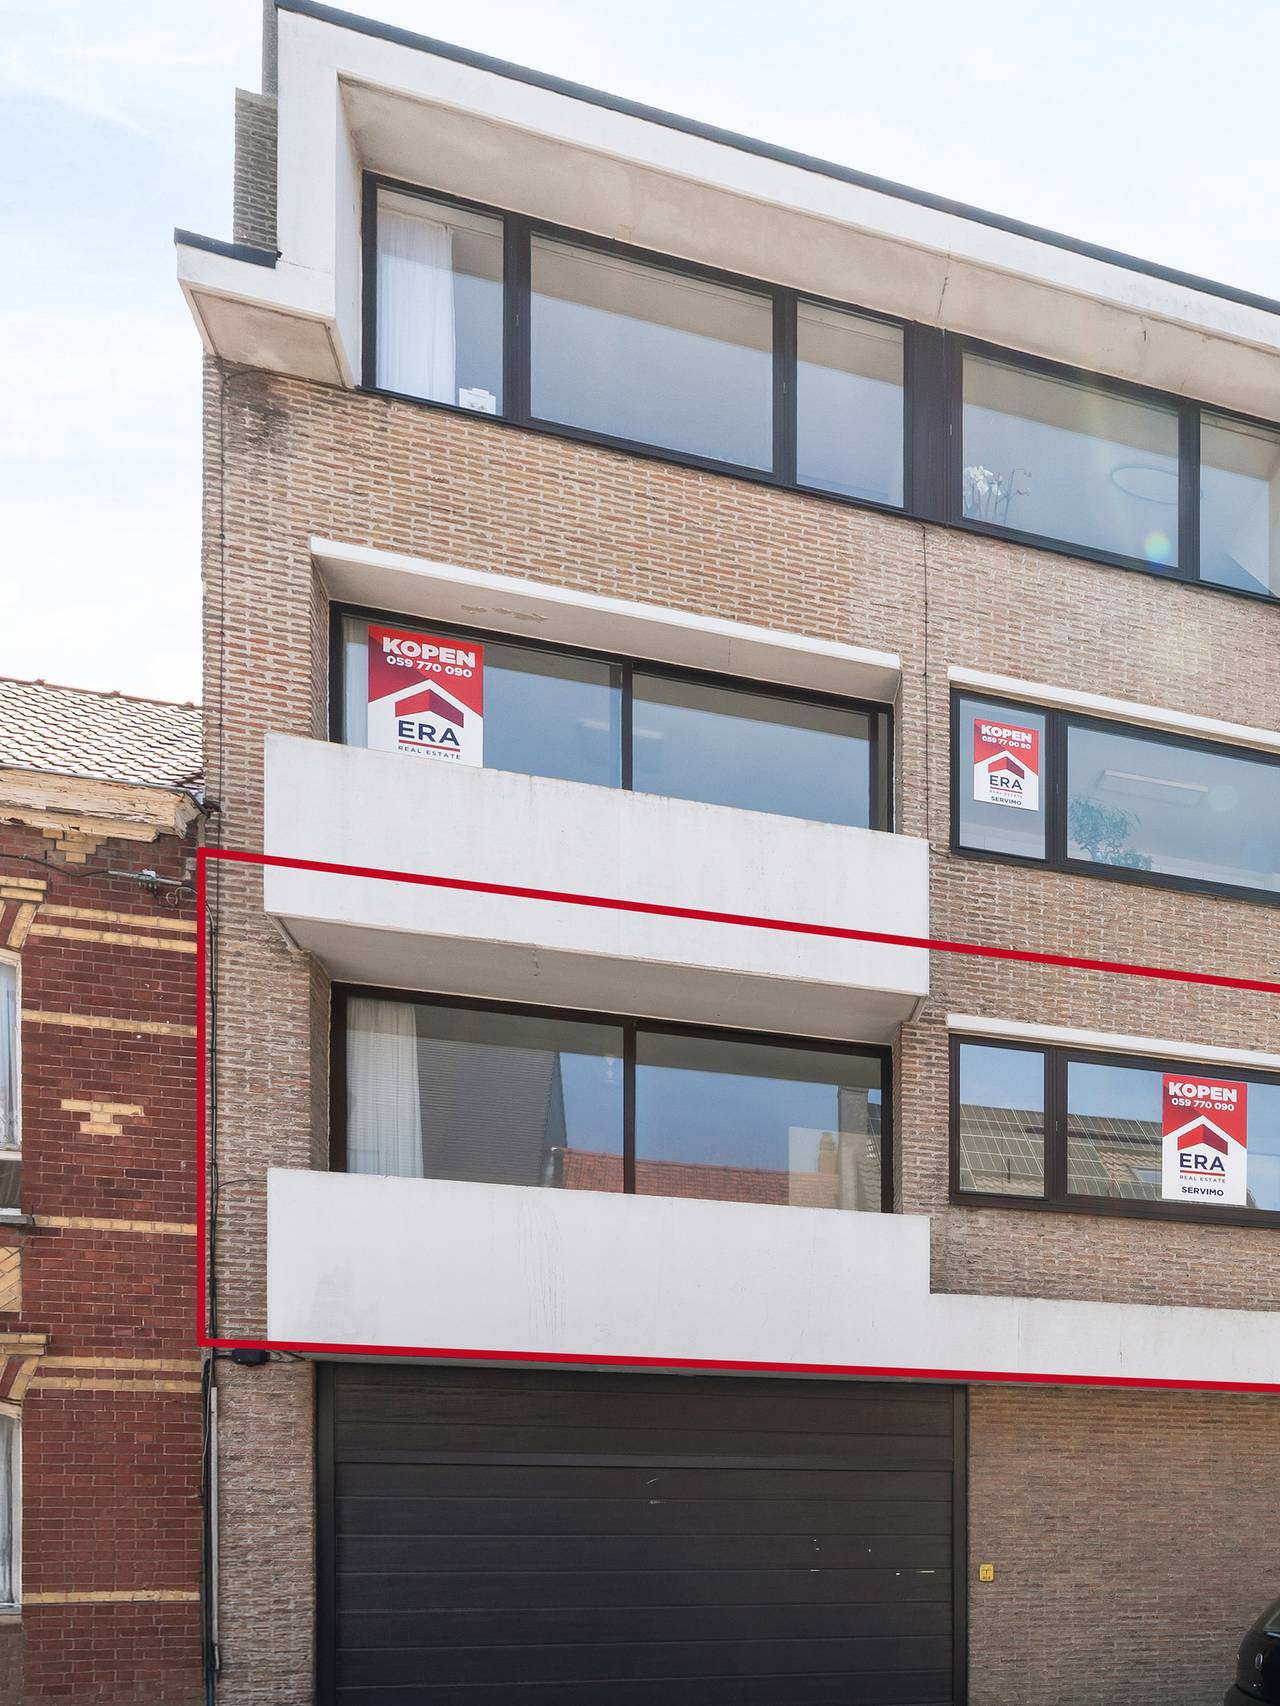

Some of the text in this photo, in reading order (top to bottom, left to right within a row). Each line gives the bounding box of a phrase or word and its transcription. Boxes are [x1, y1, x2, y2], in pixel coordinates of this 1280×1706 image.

[383, 636, 476, 668] KOPEN
[386, 655, 473, 678] 059 770 090
[398, 720, 460, 746] ERA
[981, 724, 1032, 744] KOPEN
[398, 745, 461, 760] REAL ESTATE
[989, 774, 1023, 791] ERA
[991, 796, 1022, 806] SERVIMO
[1168, 1081, 1238, 1103] KOPEN
[1171, 1097, 1235, 1112] 059 770 090
[1180, 1152, 1225, 1172] ERA
[1181, 1186, 1224, 1197] SERVIMO
